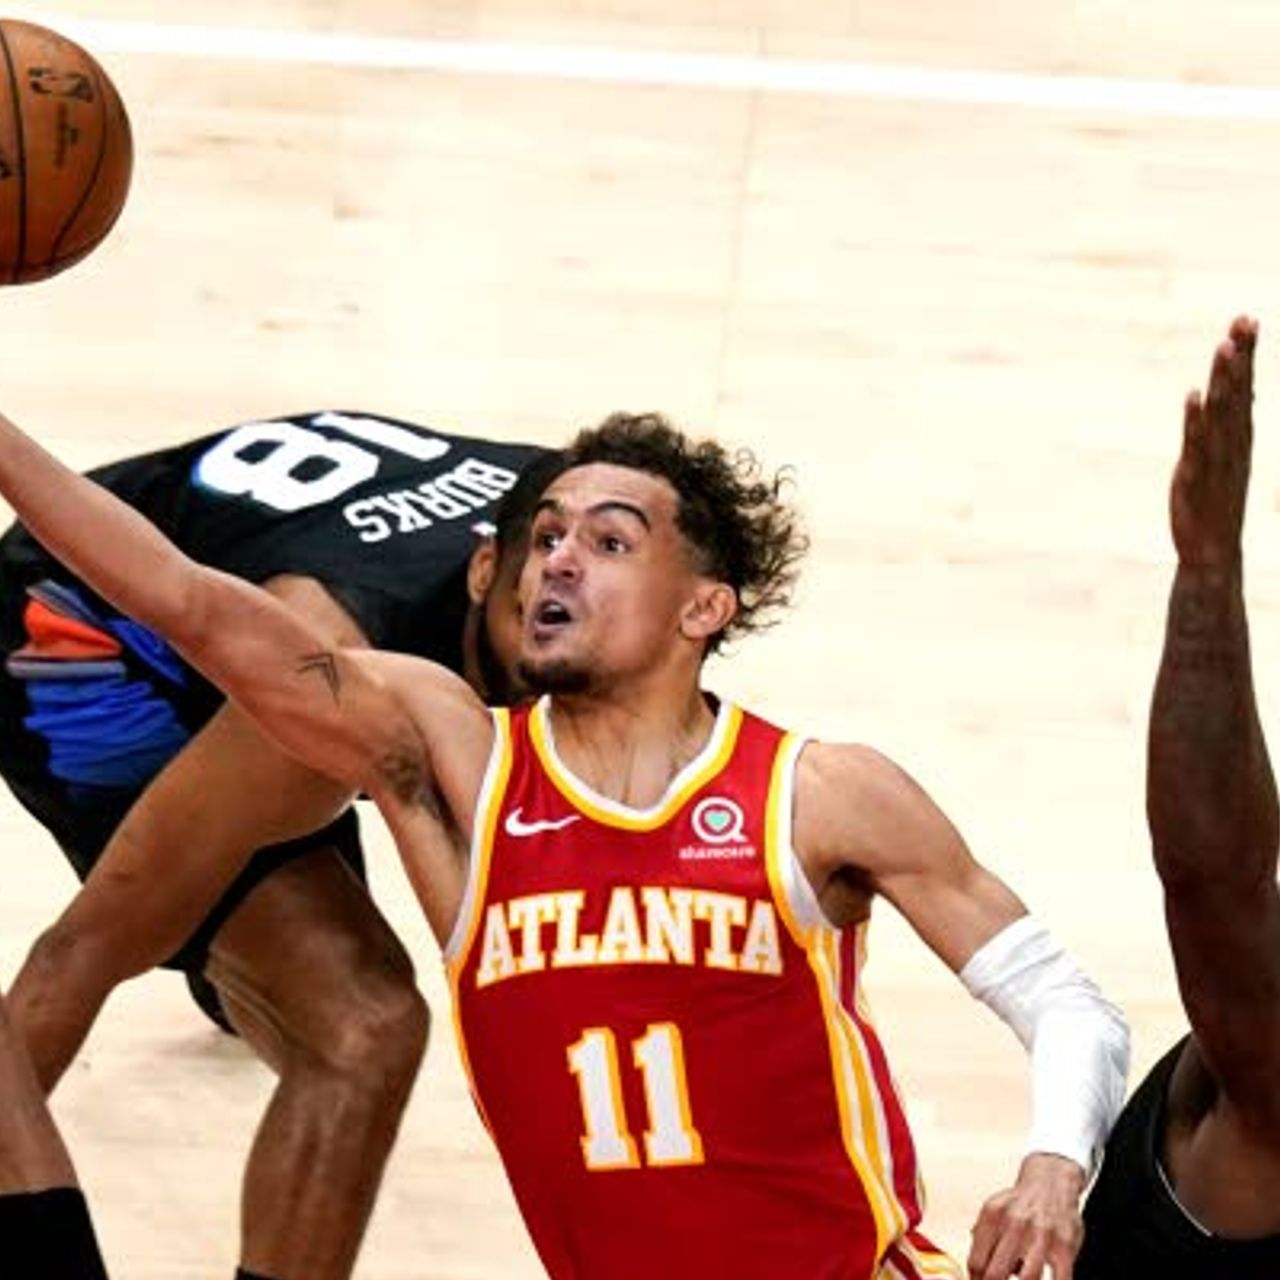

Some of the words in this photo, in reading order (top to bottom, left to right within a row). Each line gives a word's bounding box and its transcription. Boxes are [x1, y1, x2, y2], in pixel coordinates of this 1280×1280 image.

[194, 411, 452, 512] 18
[342, 457, 519, 543] BURKS
[476, 886, 784, 989] ATLANTA
[565, 1021, 706, 1171] 11
